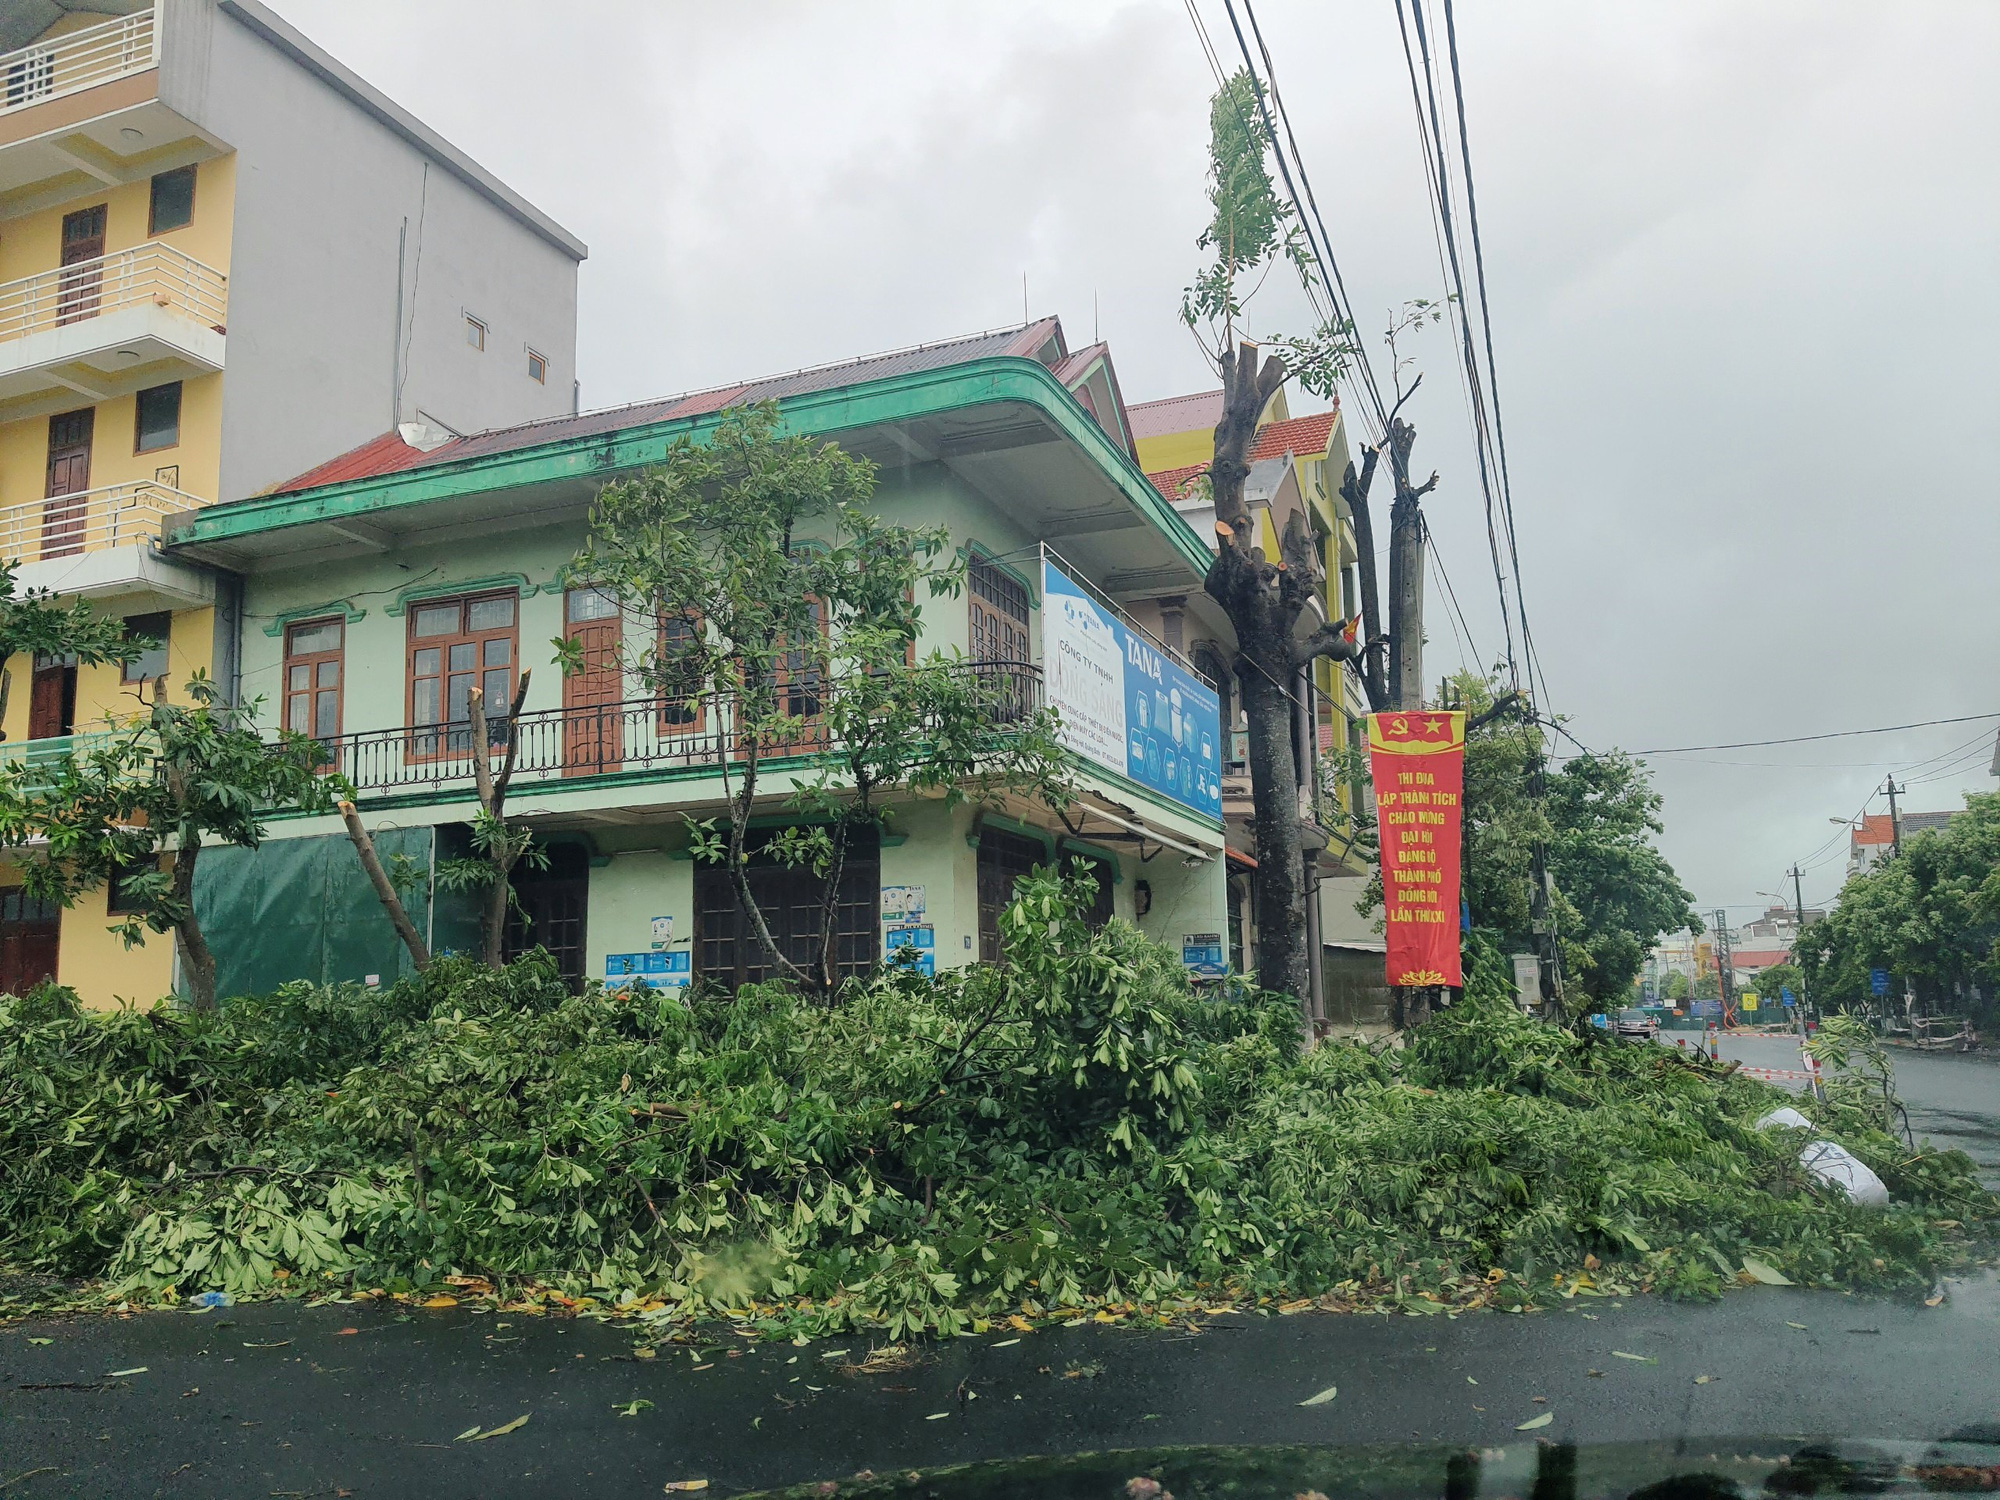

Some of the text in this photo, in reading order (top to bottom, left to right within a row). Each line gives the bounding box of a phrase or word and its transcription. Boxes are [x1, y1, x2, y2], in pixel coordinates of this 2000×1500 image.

[1060, 640, 1081, 662] CÔNG
[1083, 656, 1092, 669] TY
[1094, 664, 1113, 684] TNHH
[1125, 633, 1163, 685] TANA
[1398, 772, 1413, 785] THI
[1377, 789, 1457, 808] LẬP THÀNH TÍCH
[1389, 809, 1445, 825] CHÀO MỪNG
[1401, 830, 1418, 846] ĐẠI
[1398, 846, 1426, 863] ĐẢNG
[1393, 867, 1442, 884] THÀNH PHỐ
[1398, 886, 1426, 902] ĐỒNG
[1391, 905, 1412, 922] LẦN
